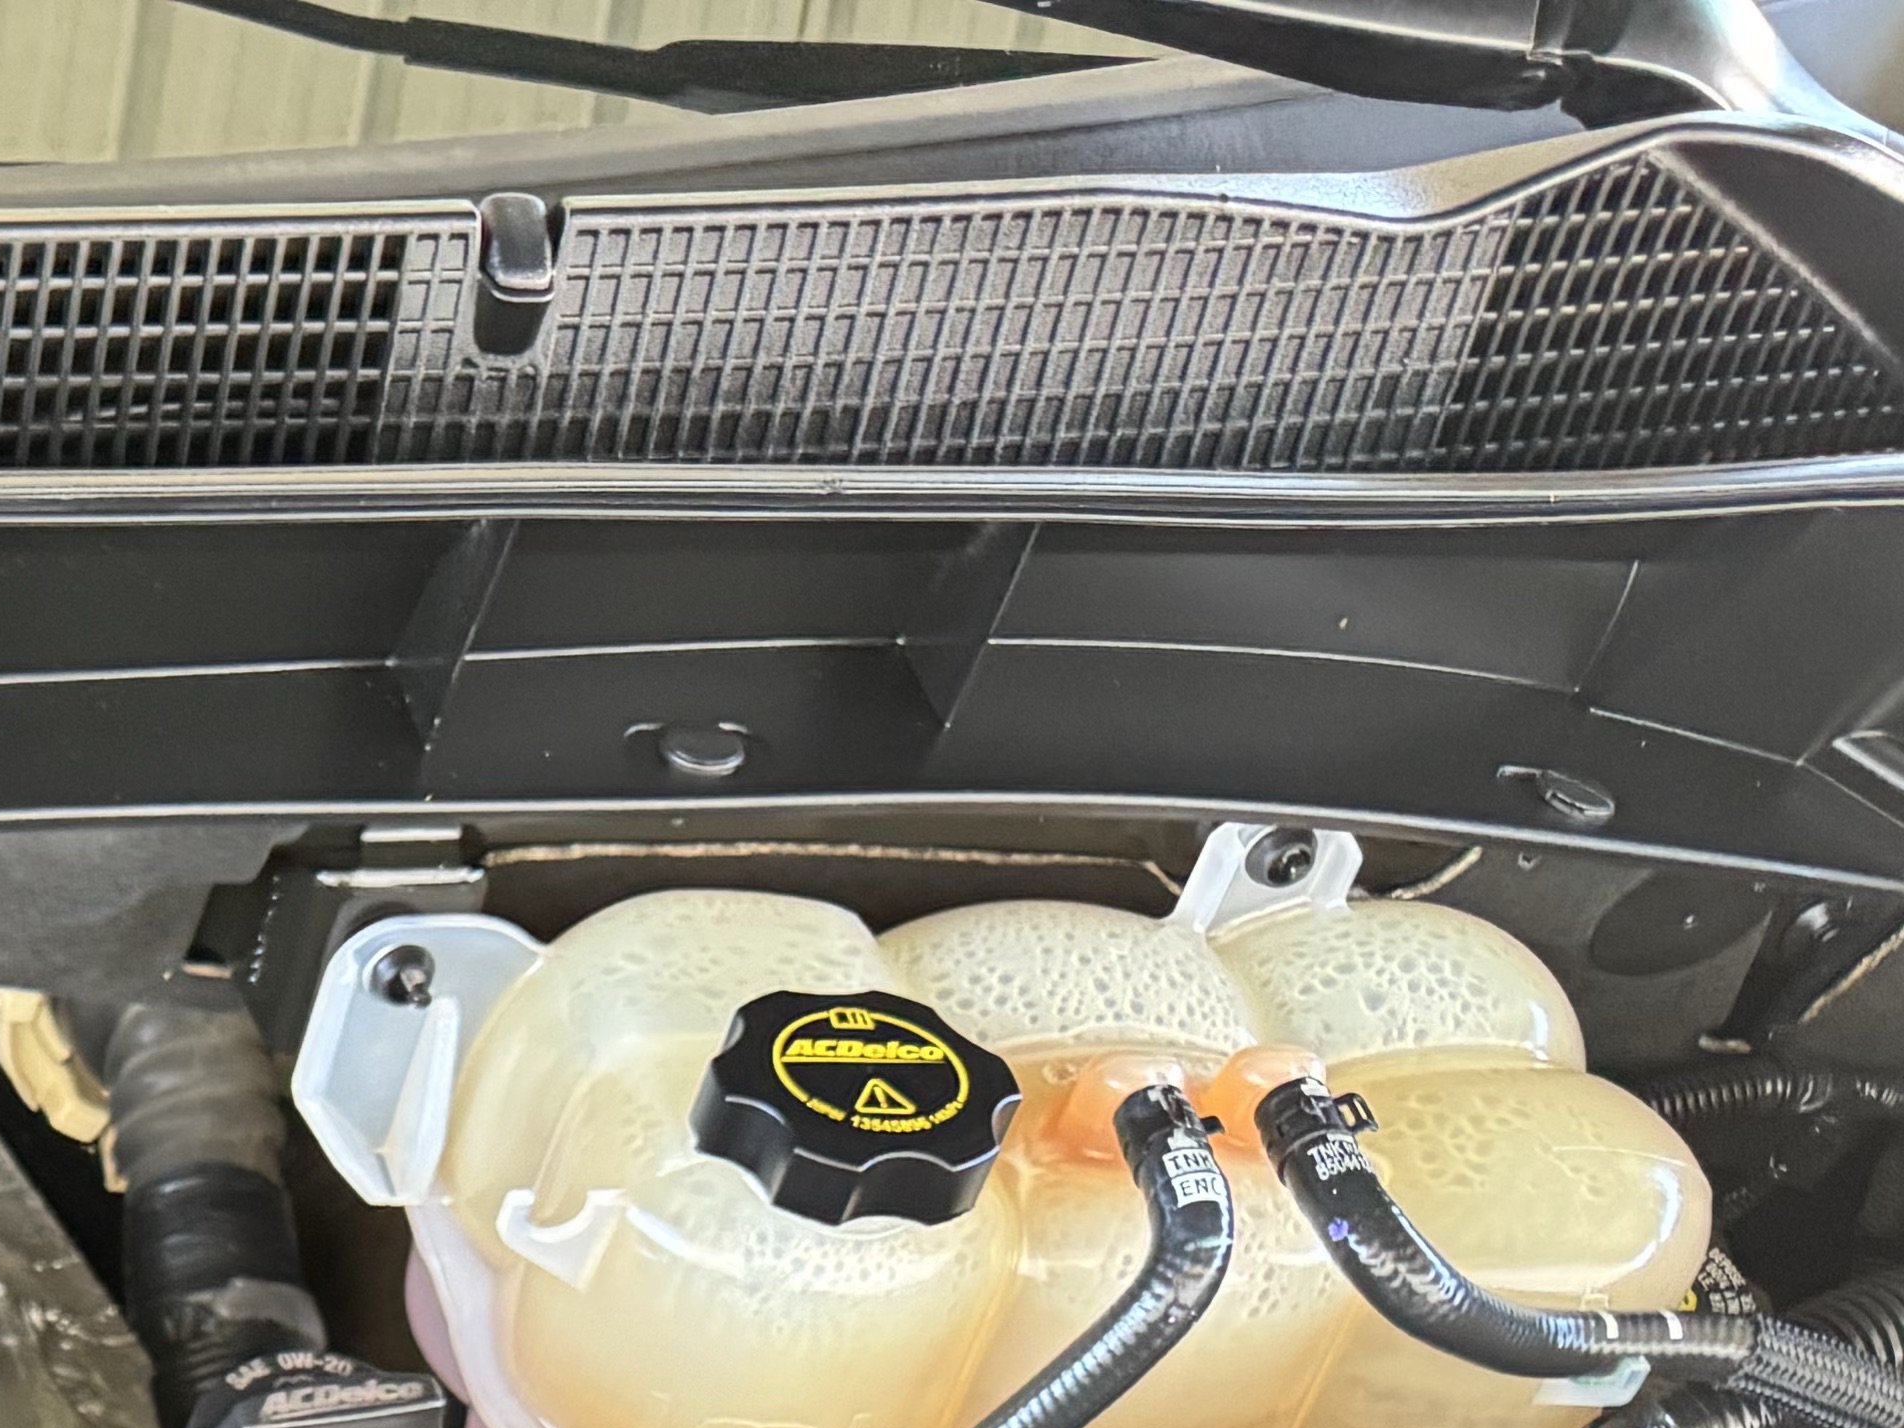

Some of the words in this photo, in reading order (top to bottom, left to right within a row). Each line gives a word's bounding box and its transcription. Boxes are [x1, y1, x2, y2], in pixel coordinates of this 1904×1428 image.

[785, 1039, 945, 1061] ACDelco
[225, 1358, 271, 1391] SAE
[260, 1380, 424, 1419] ACDelco
